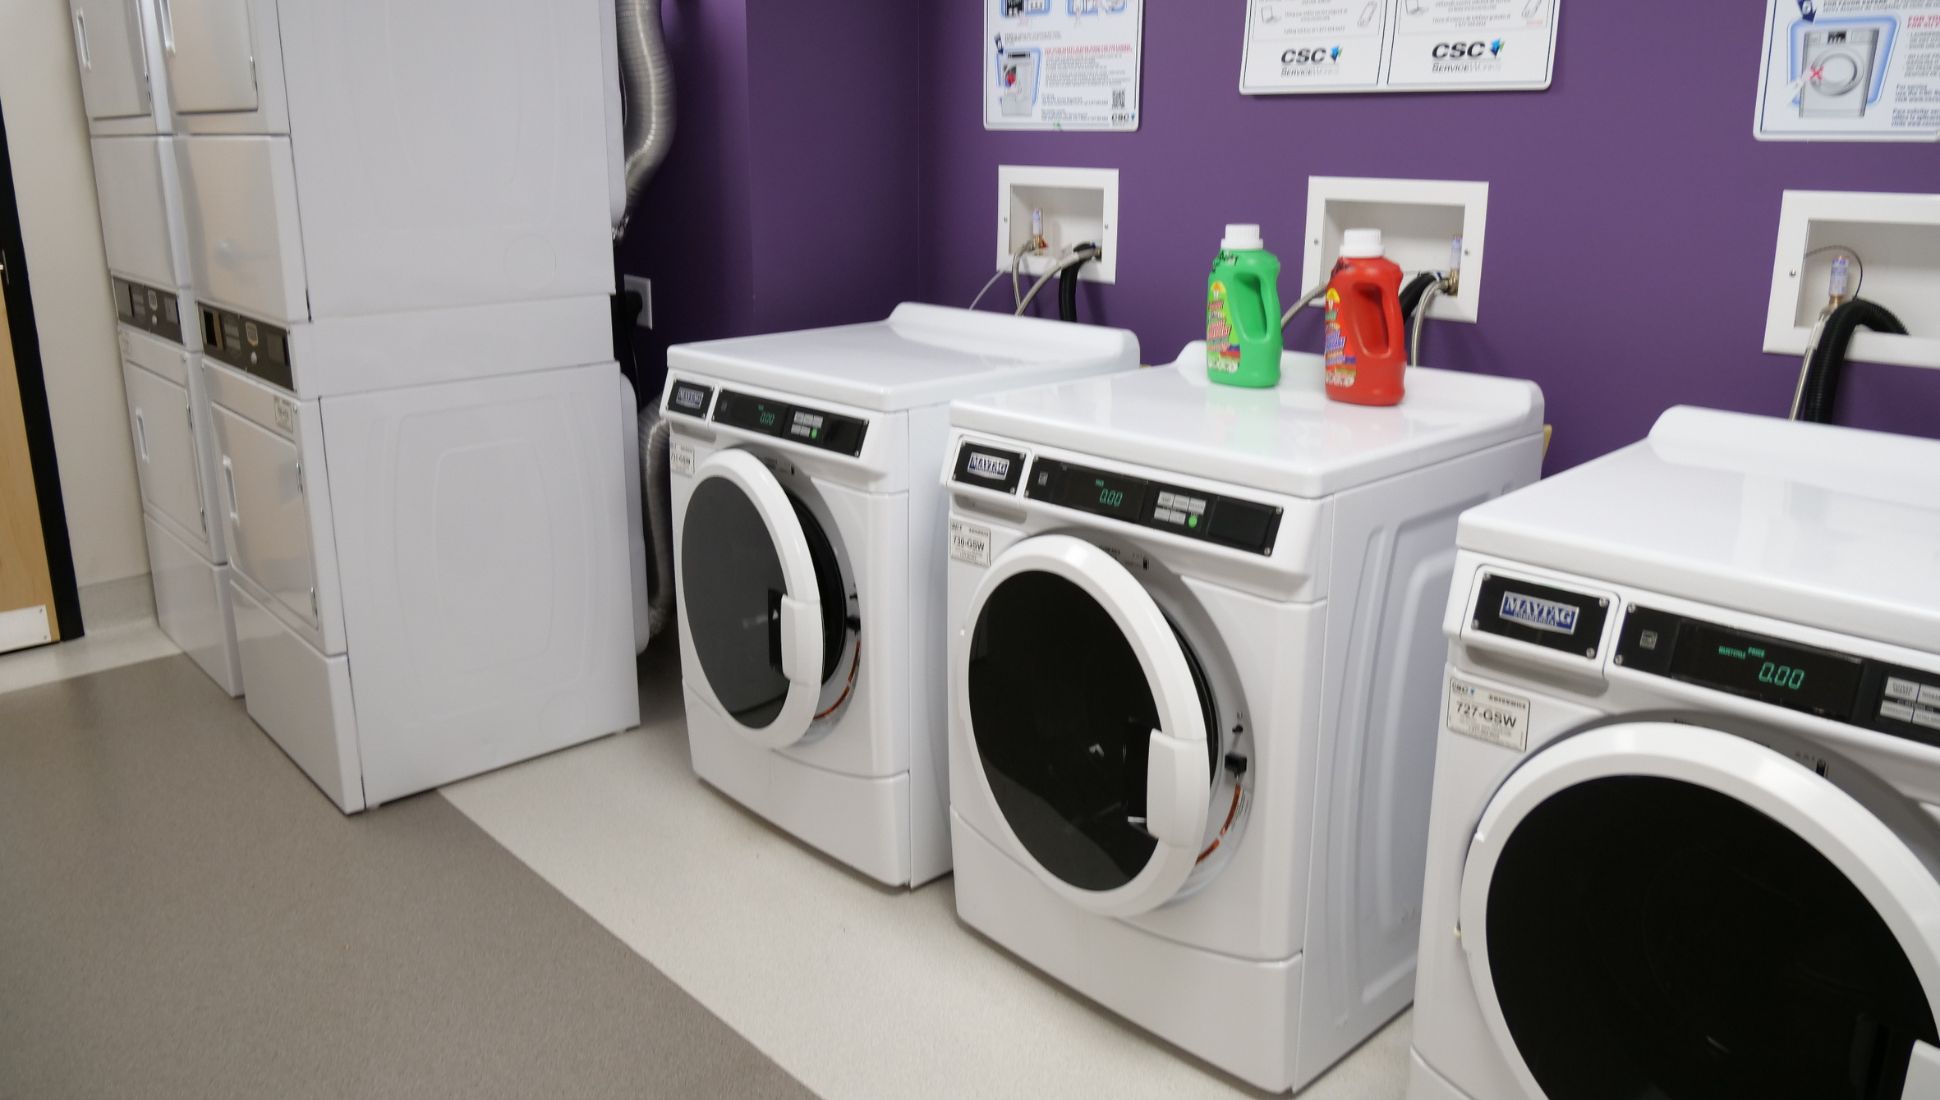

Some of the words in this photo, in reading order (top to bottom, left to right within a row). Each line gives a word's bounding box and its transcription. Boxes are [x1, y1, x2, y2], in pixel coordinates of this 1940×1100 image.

[1281, 47, 1327, 64] CSC
[1431, 41, 1486, 59] CSC
[968, 454, 1008, 476] MAYTAG
[1100, 488, 1123, 507] 0.00
[1503, 595, 1575, 627] MAYTAG
[1758, 661, 1805, 690] 0.00
[1456, 702, 1517, 728] 727-GSW
